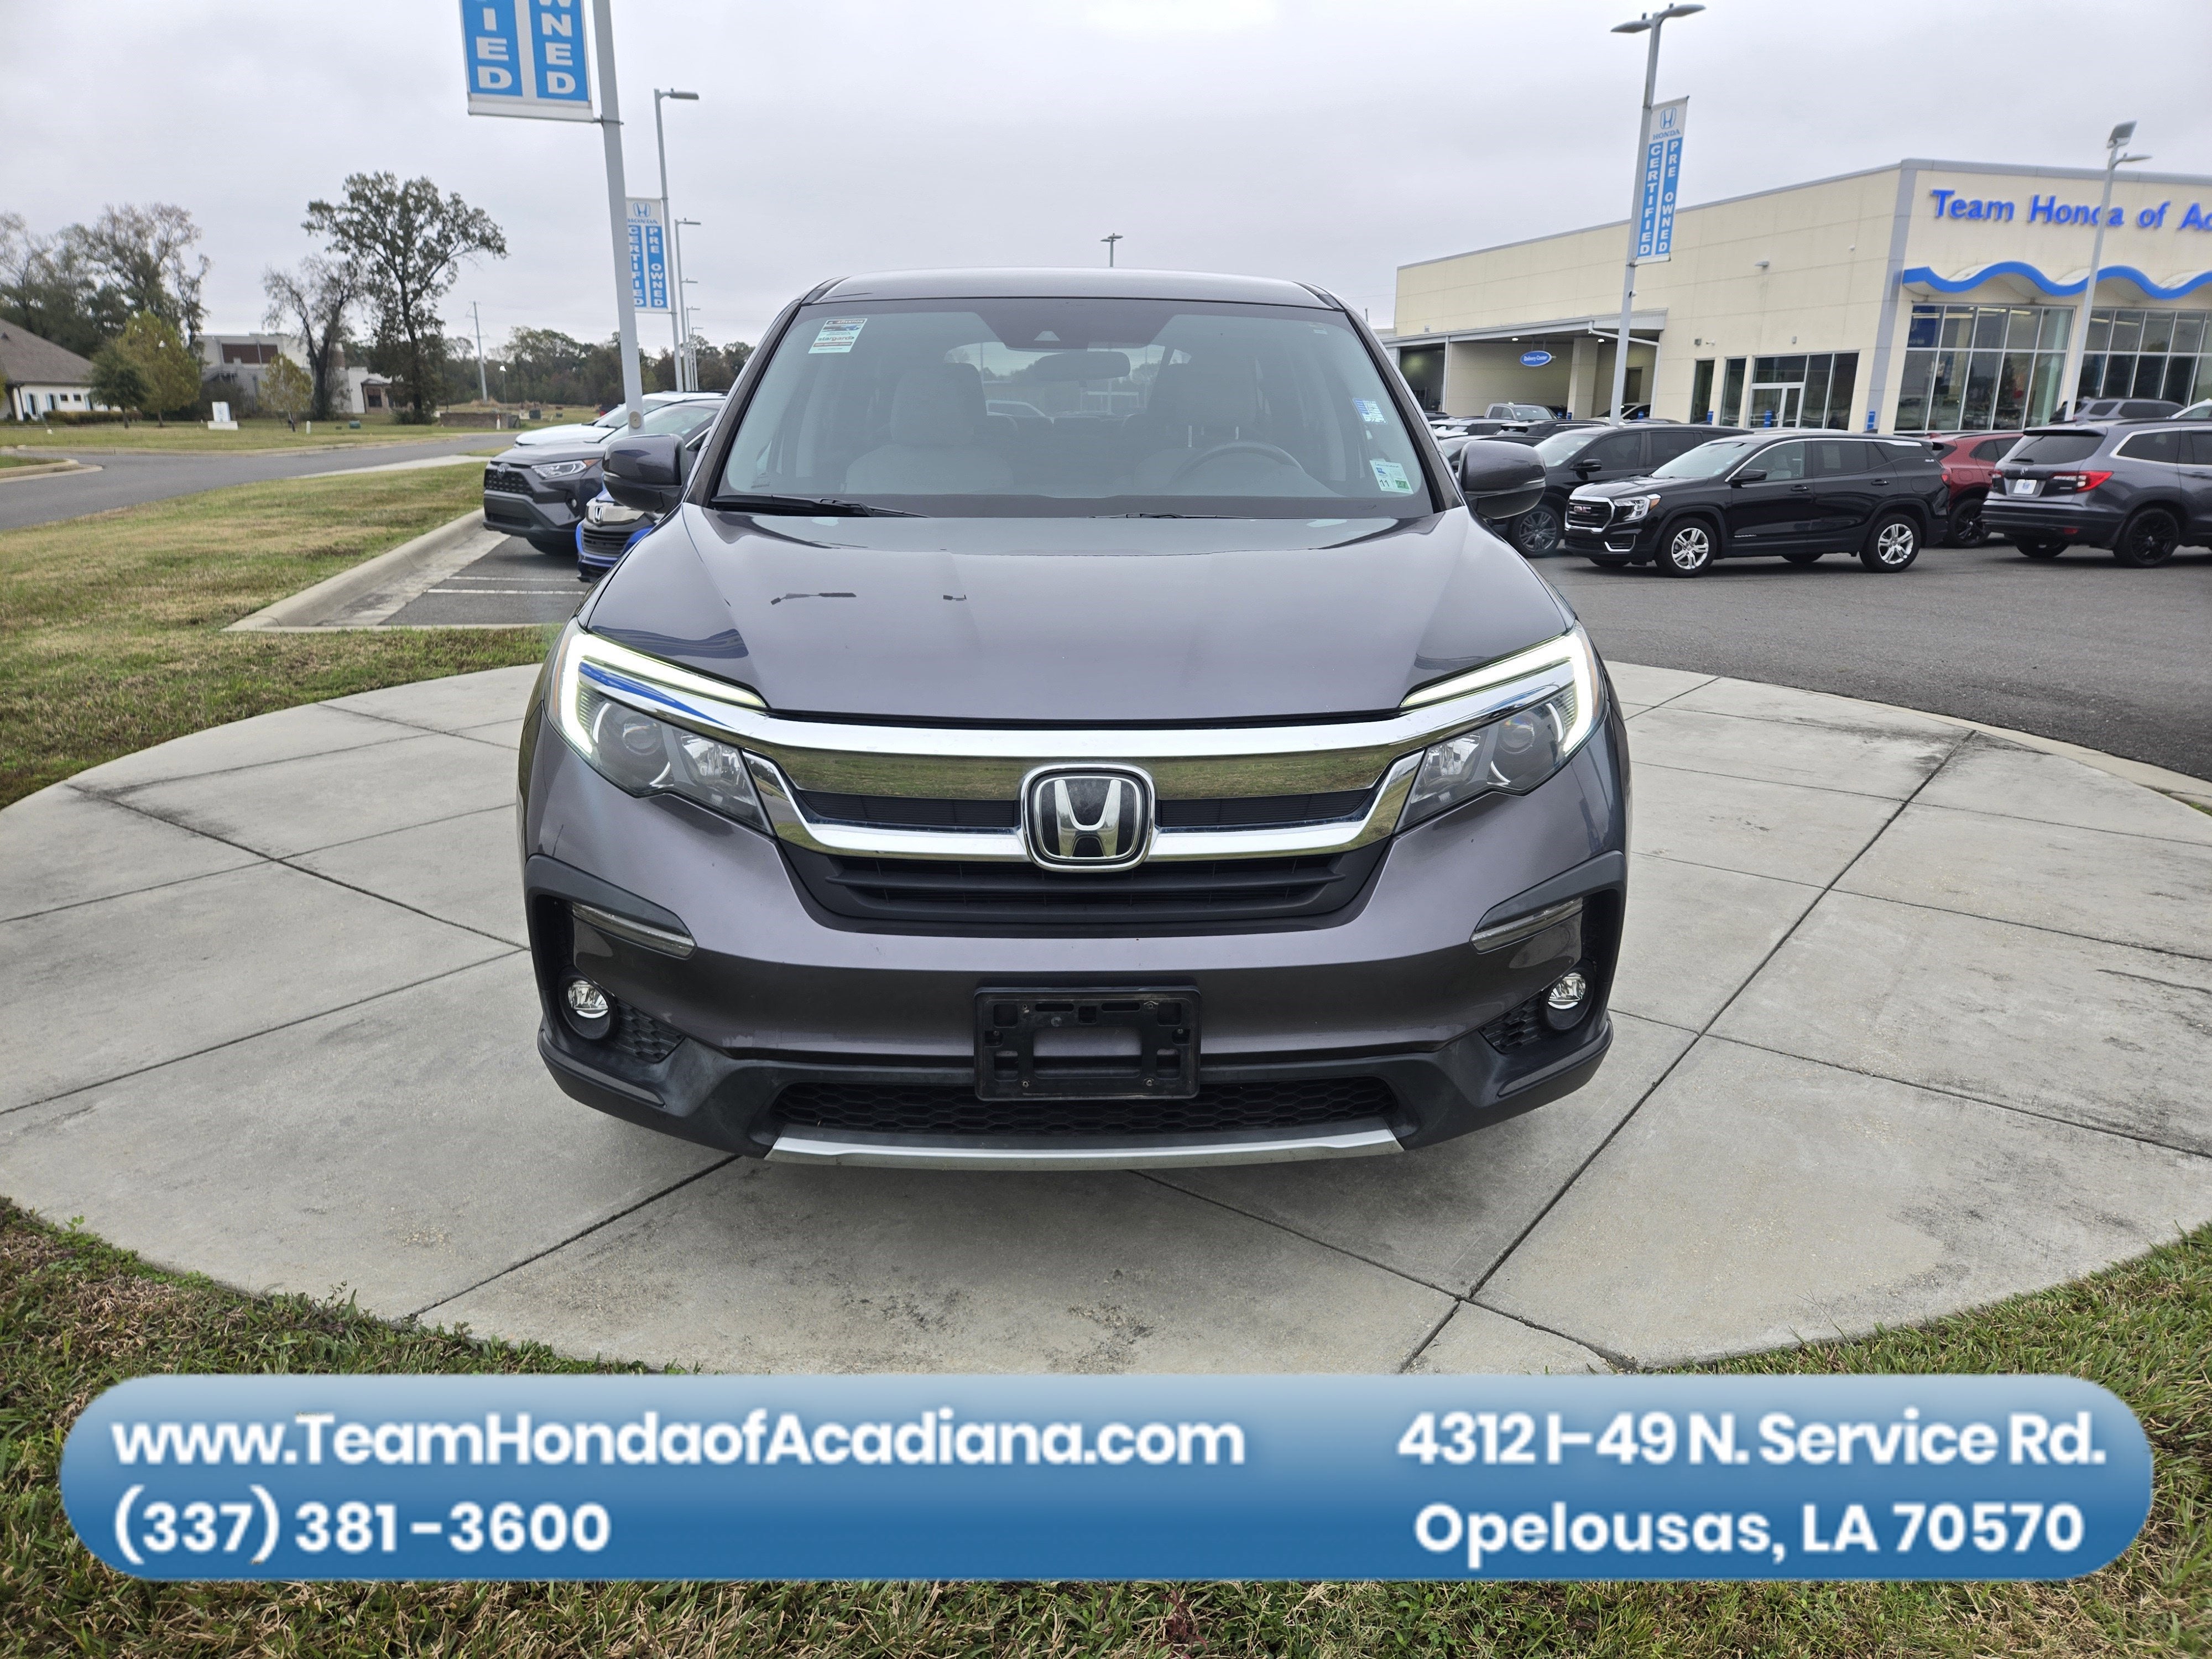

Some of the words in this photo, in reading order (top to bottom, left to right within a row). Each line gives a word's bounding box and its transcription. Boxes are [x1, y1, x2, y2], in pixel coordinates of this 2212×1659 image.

[476, 0, 512, 89] IED
[1653, 128, 1680, 140] HONDA
[1668, 140, 1678, 178] PRE
[1640, 145, 1661, 254] CERTIFIED
[1932, 189, 2015, 221] Team
[2139, 201, 2170, 228] of
[649, 227, 660, 254] PRE
[1659, 191, 1674, 252] OWNED
[629, 227, 644, 306] CERTIFIED
[650, 263, 664, 306] OWNED
